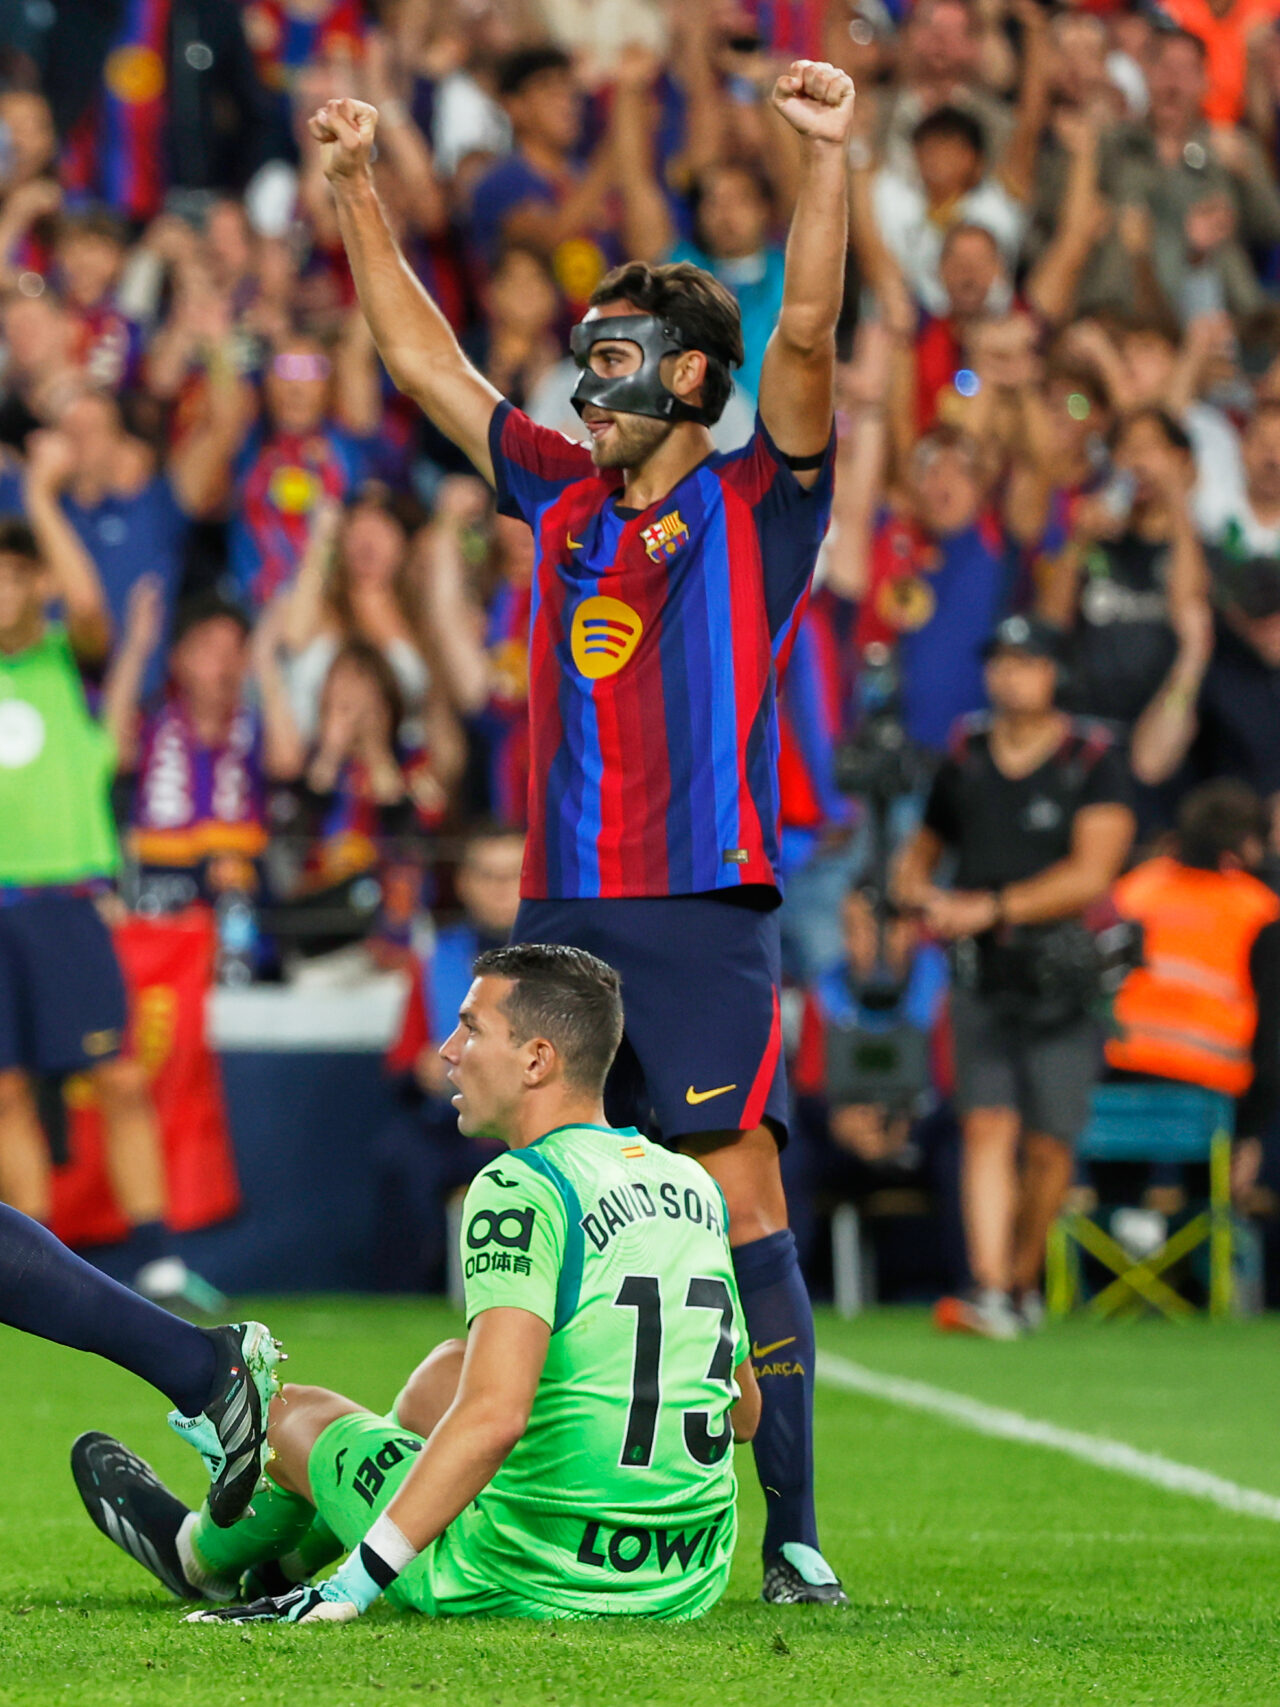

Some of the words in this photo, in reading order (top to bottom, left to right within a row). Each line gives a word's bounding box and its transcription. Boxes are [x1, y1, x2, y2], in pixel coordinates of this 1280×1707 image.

[580, 1183, 657, 1253] DAVID
[465, 1251, 533, 1280] OD体育
[612, 1275, 740, 1467] 13
